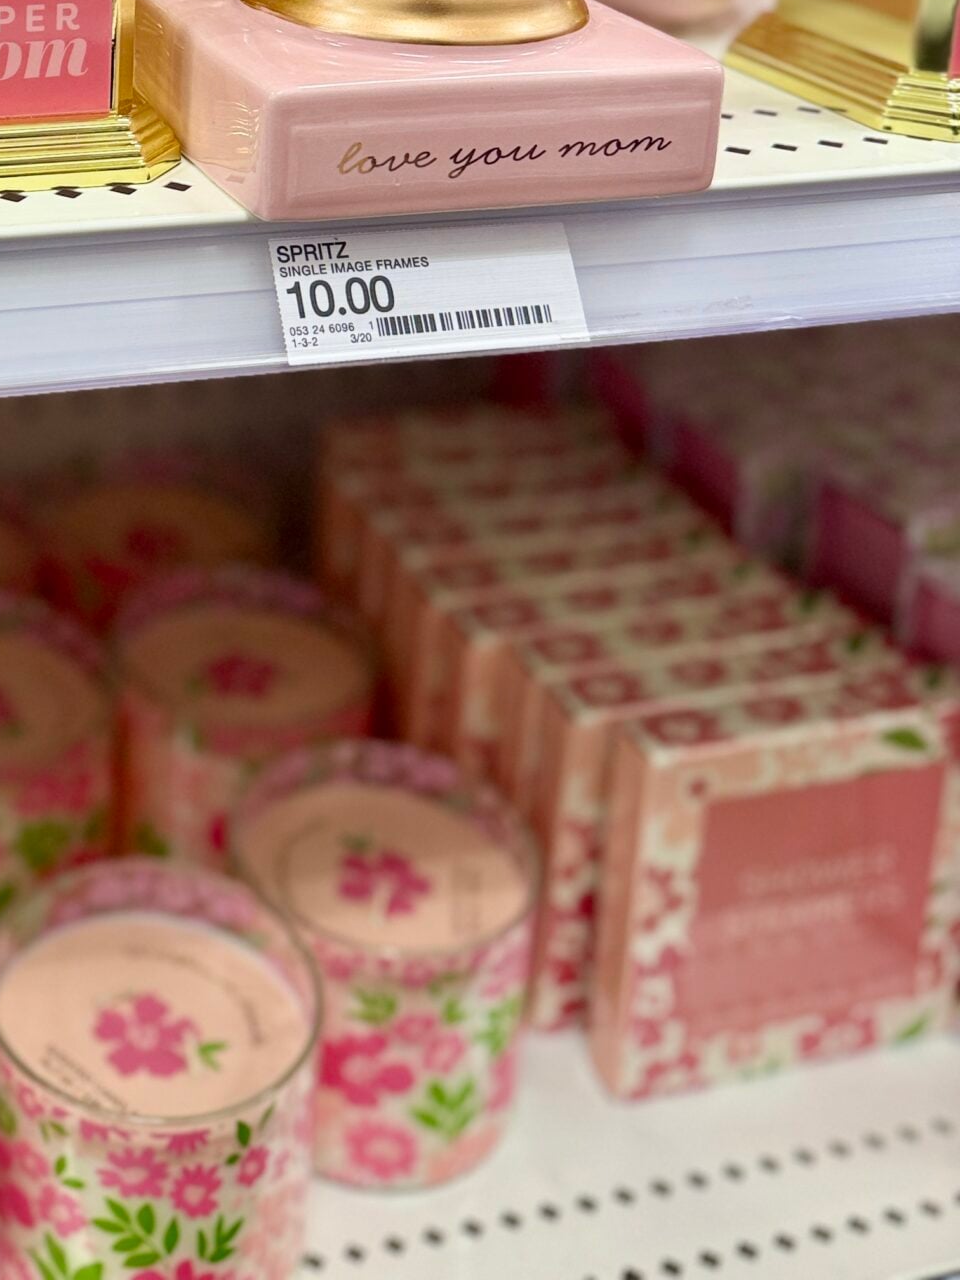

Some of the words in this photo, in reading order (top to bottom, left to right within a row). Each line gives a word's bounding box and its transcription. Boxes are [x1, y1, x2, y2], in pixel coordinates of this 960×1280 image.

[337, 141, 438, 176] love
[448, 138, 547, 179] you
[558, 132, 673, 158] mom
[276, 241, 350, 264] SPRITZ
[279, 263, 328, 278] SINGLE
[331, 260, 373, 274] IMAGE
[376, 256, 430, 270] FRAMES
[286, 275, 395, 319] 10.00
[289, 325, 309, 336] 053
[312, 324, 325, 335] 24
[328, 322, 355, 333] 6096
[291, 336, 319, 348] 1-3-2
[350, 332, 372, 344] 3/20
